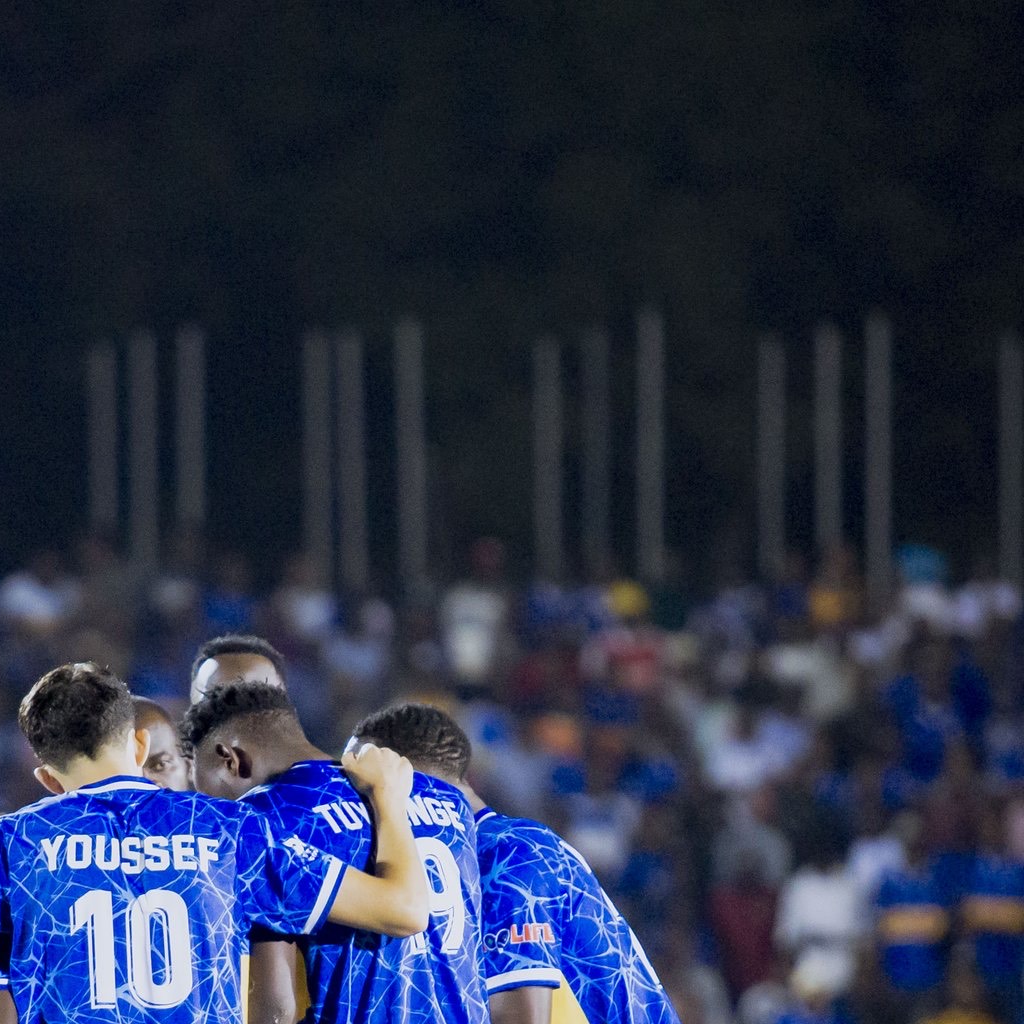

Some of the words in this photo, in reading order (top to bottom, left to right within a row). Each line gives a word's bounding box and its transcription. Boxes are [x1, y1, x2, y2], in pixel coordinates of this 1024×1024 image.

[41, 834, 219, 874] YOUSSEF
[409, 837, 465, 955] 9
[69, 889, 193, 1010] 10
